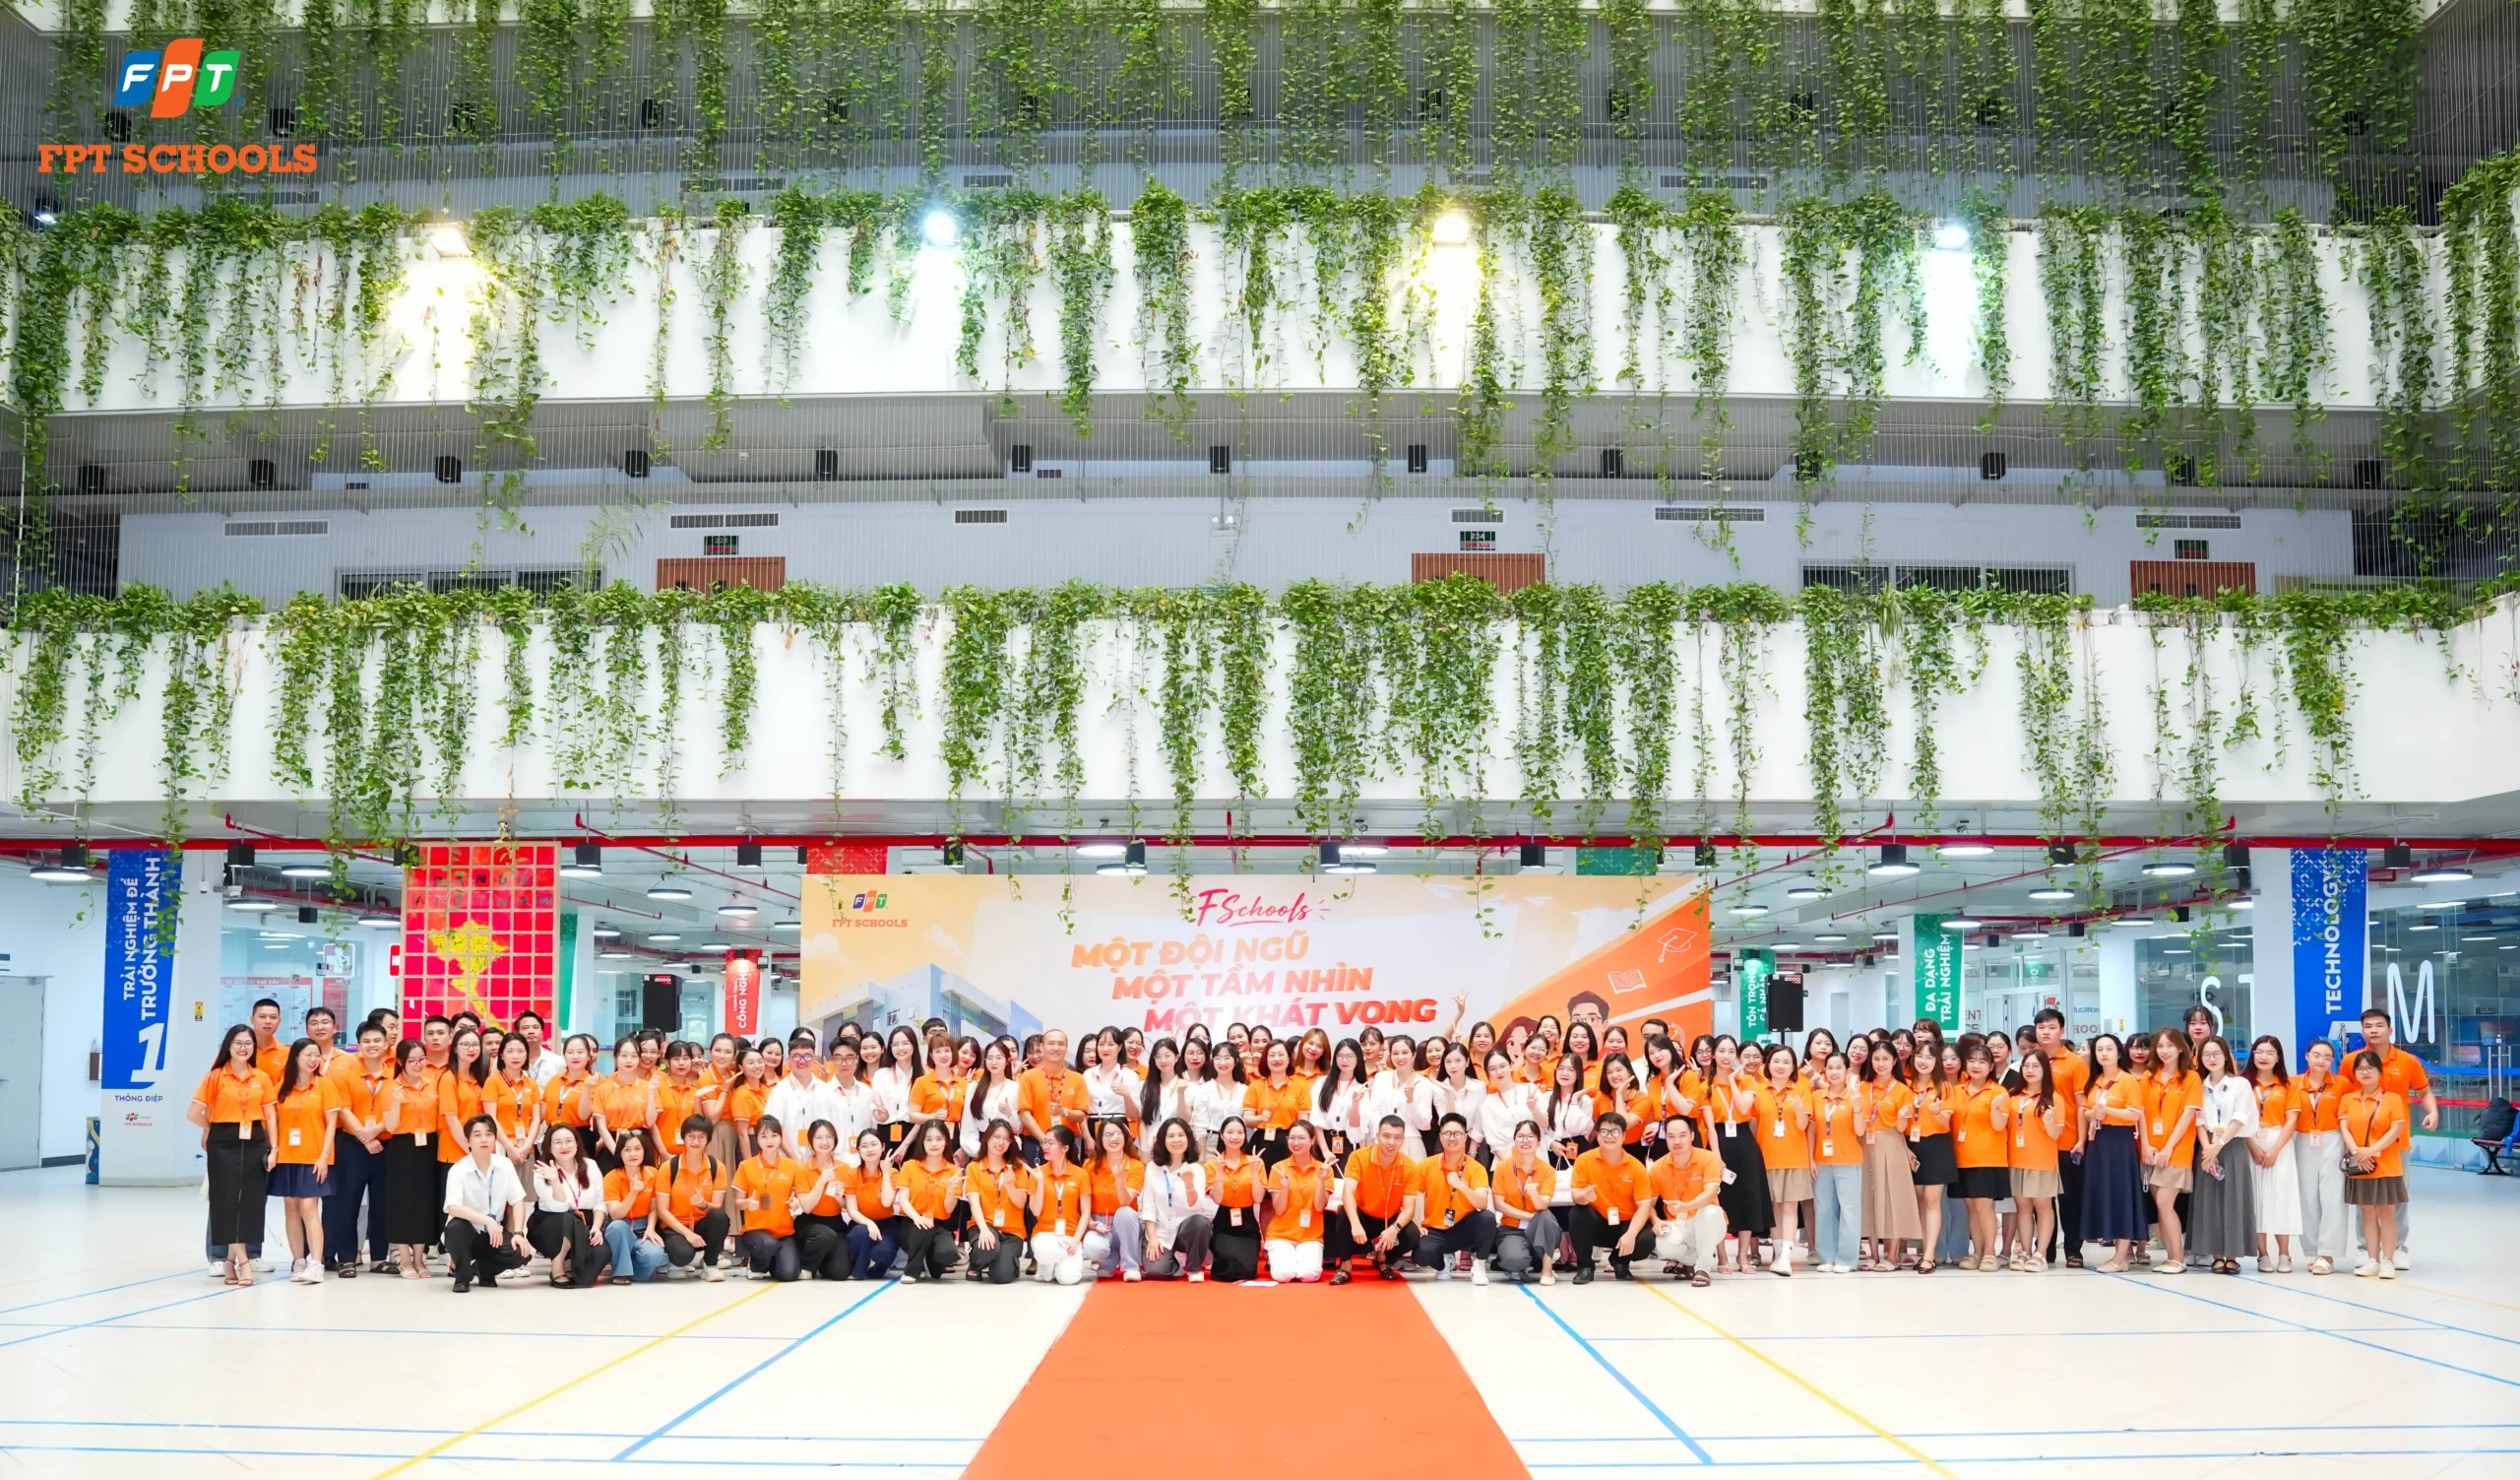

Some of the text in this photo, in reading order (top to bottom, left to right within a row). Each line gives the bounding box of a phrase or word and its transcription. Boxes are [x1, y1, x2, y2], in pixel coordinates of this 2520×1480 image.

[120, 877, 141, 1000] TRẢI NGHIỆM ĐỂ
[138, 857, 160, 1021] TRƯỞNG THÀNH
[832, 919, 908, 928] FPT SCHOOLS
[2323, 868, 2343, 1015] TECHNOLOGY
[1071, 930, 1309, 973] MỘT ĐỘI NGŨ
[1111, 962, 1374, 1004] MỘT TẦM NHÌN
[1923, 948, 1939, 1012] ĐA DẠNG
[1936, 933, 1953, 1023] TRẢI NGHIỆM
[736, 998, 747, 1029] CÔNG
[1143, 997, 1438, 1037] MỘT KHÁT VỌNG
[1746, 1006, 1757, 1028] TÔN
[130, 1022, 165, 1083] 1
[114, 1093, 163, 1104] THÔNG ĐIỆP
